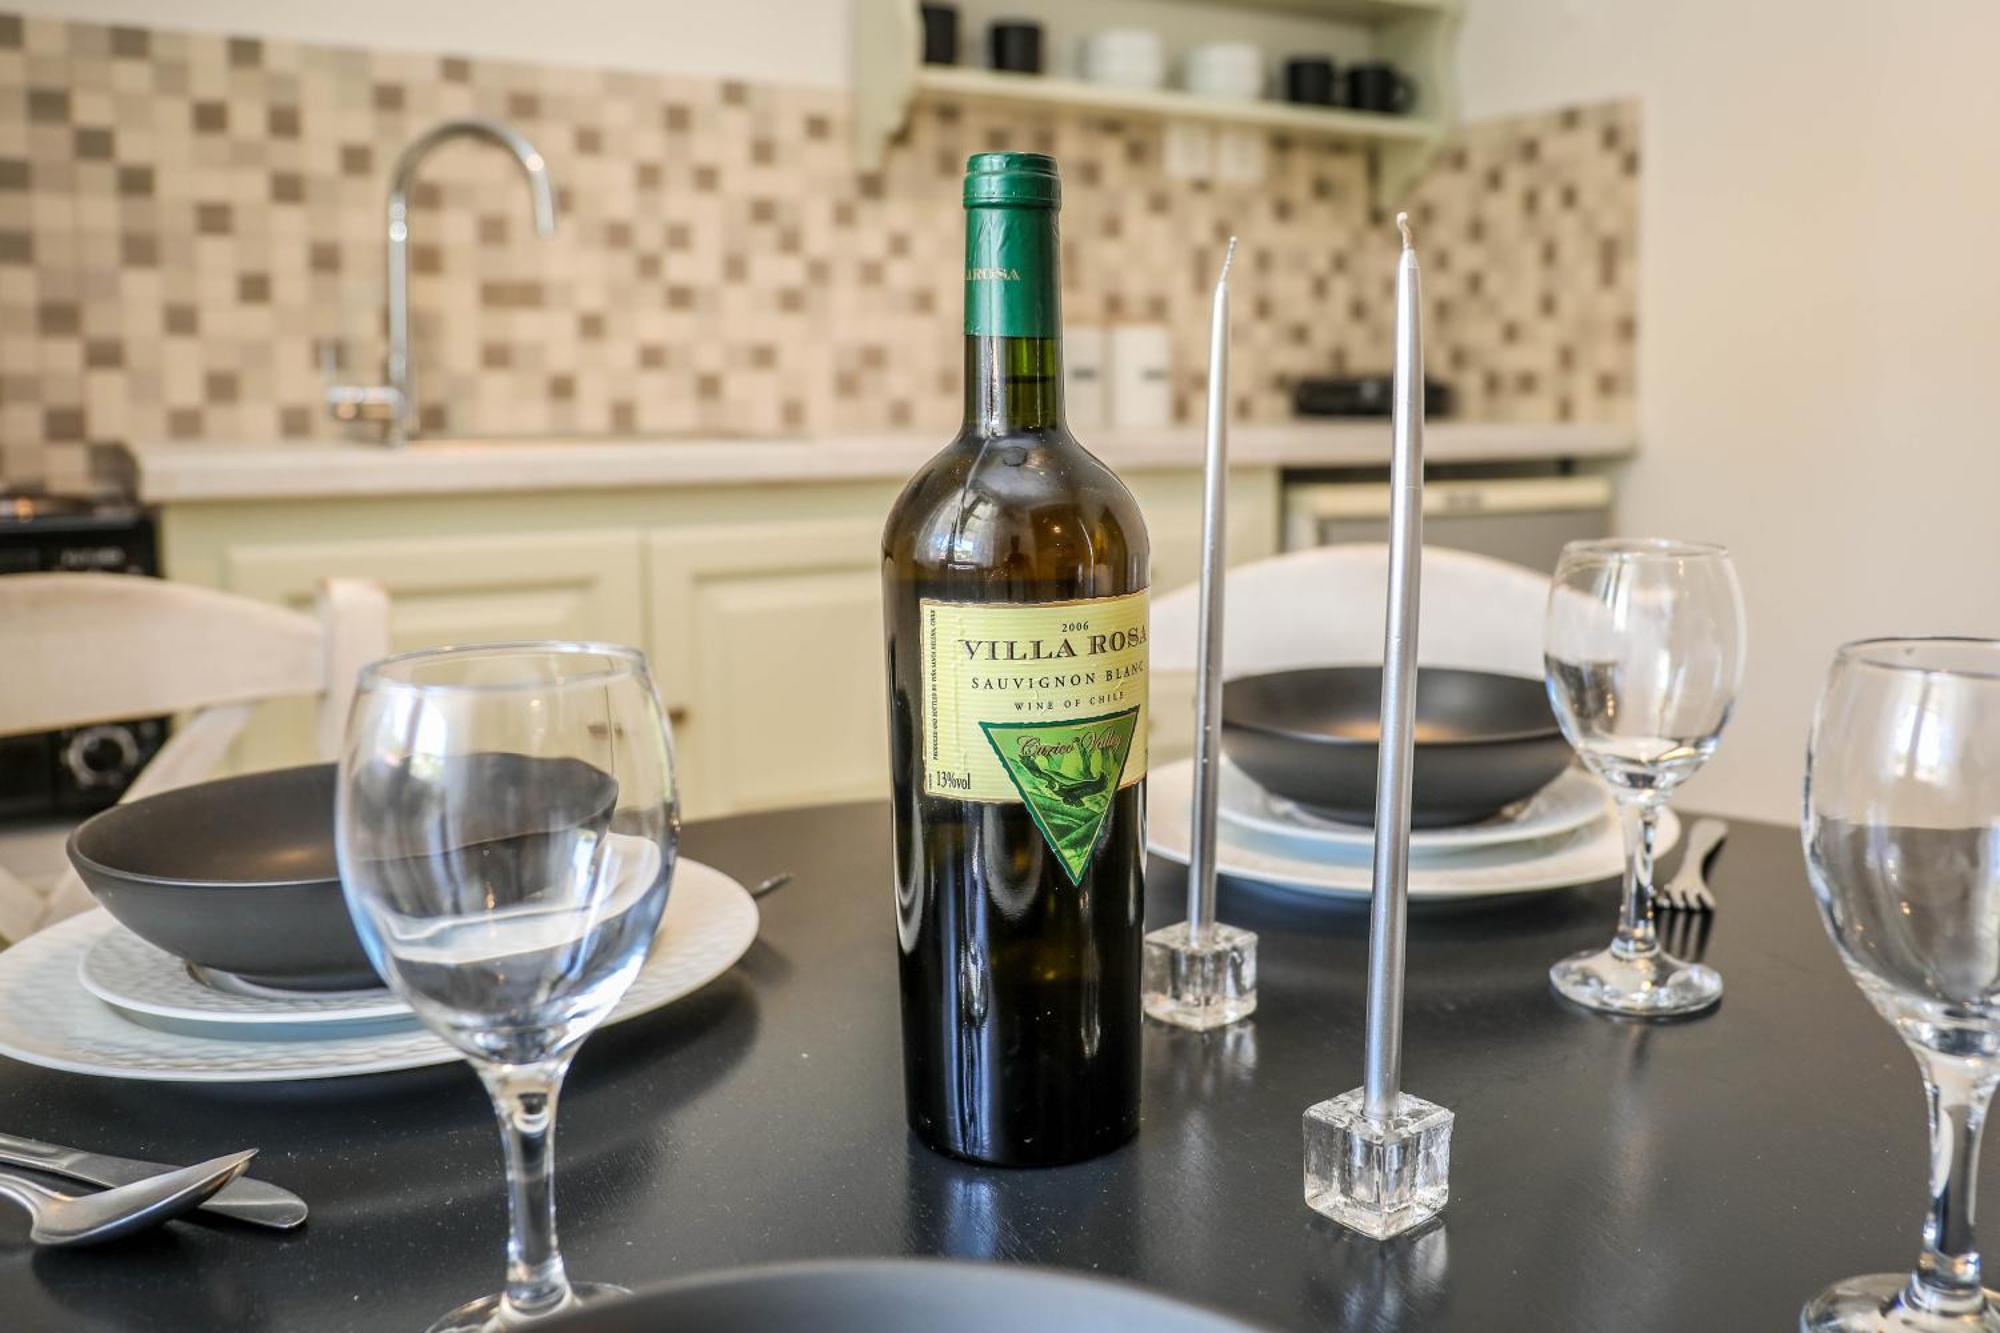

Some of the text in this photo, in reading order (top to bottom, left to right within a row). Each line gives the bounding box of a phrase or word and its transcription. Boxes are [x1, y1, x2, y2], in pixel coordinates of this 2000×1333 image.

[1062, 621, 1089, 632] 2006
[958, 625, 1147, 661] VILLA ROSA
[971, 660, 1144, 690] SAUVIGNON BLANC
[1014, 691, 1124, 711] WINE OF CHILE
